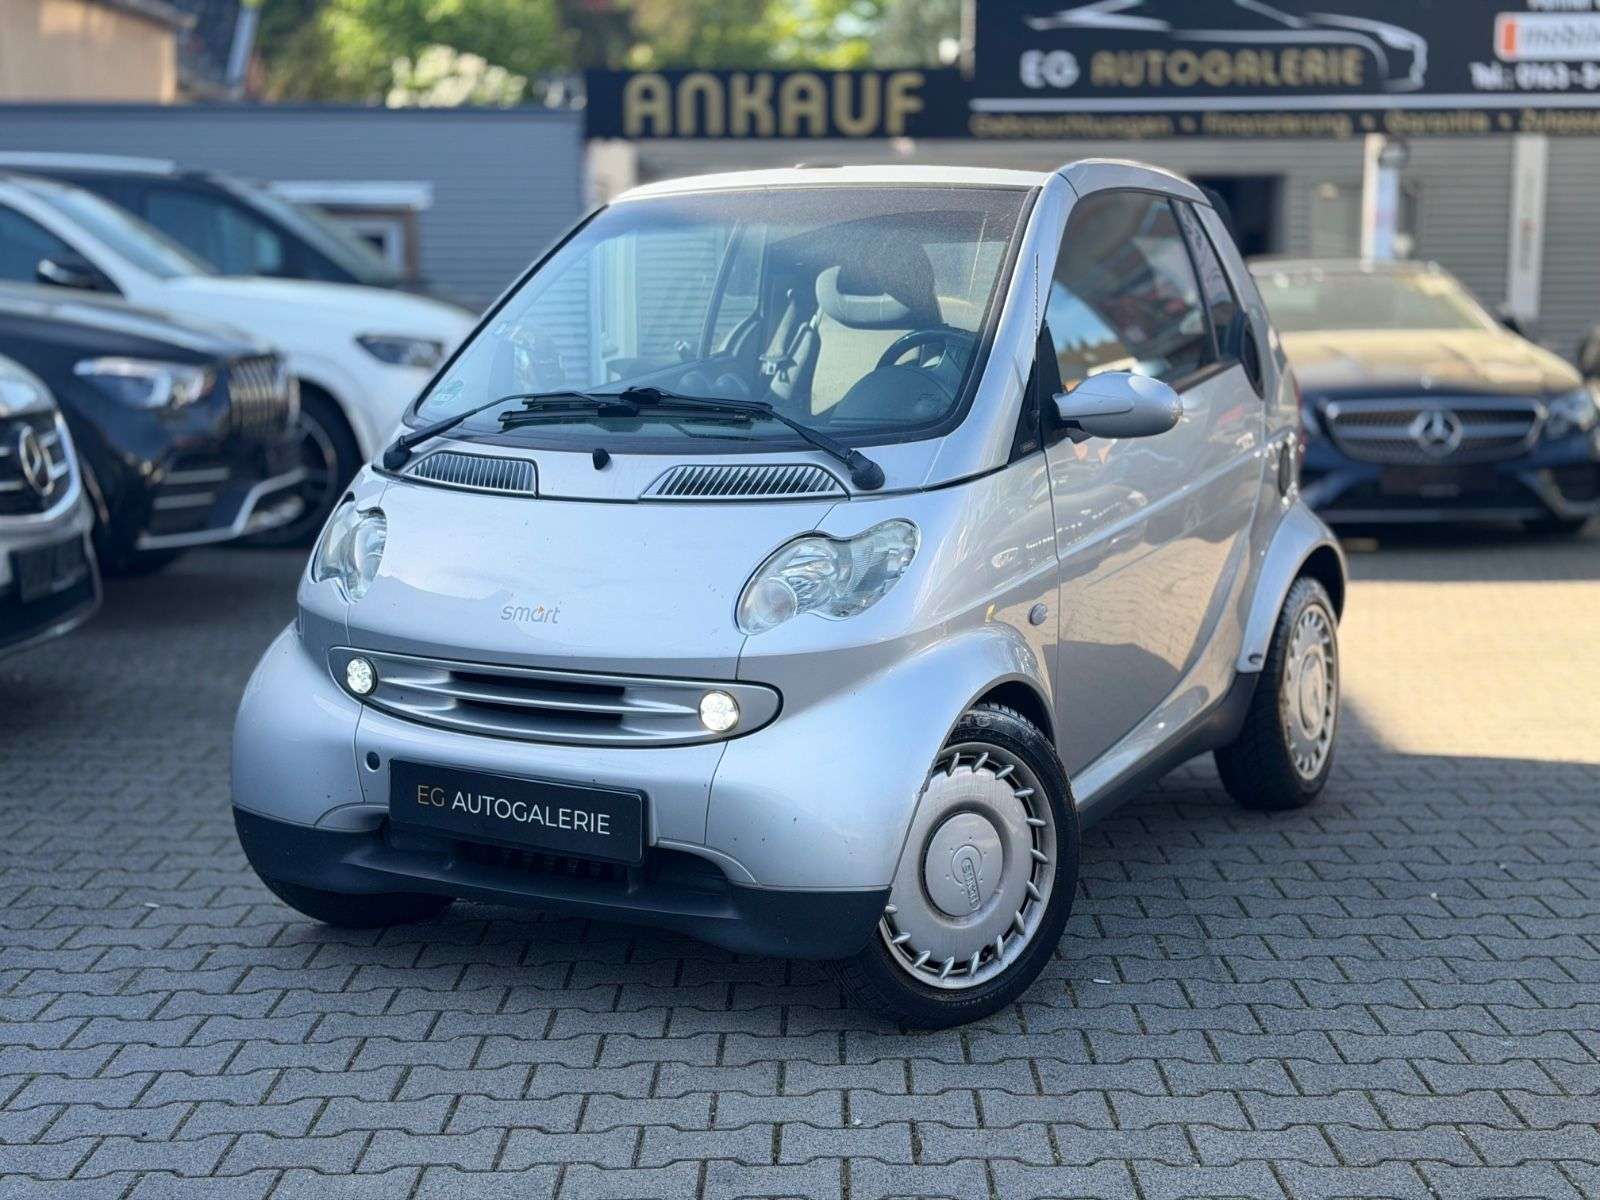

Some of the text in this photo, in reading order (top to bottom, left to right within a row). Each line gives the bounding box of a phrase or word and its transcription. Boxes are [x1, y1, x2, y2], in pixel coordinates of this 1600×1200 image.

[1019, 47, 1364, 89] EG AUTOGALERIE
[622, 72, 925, 137] ANKAUF
[500, 605, 561, 624] smart
[416, 784, 611, 836] EG AUTOGALERIE
